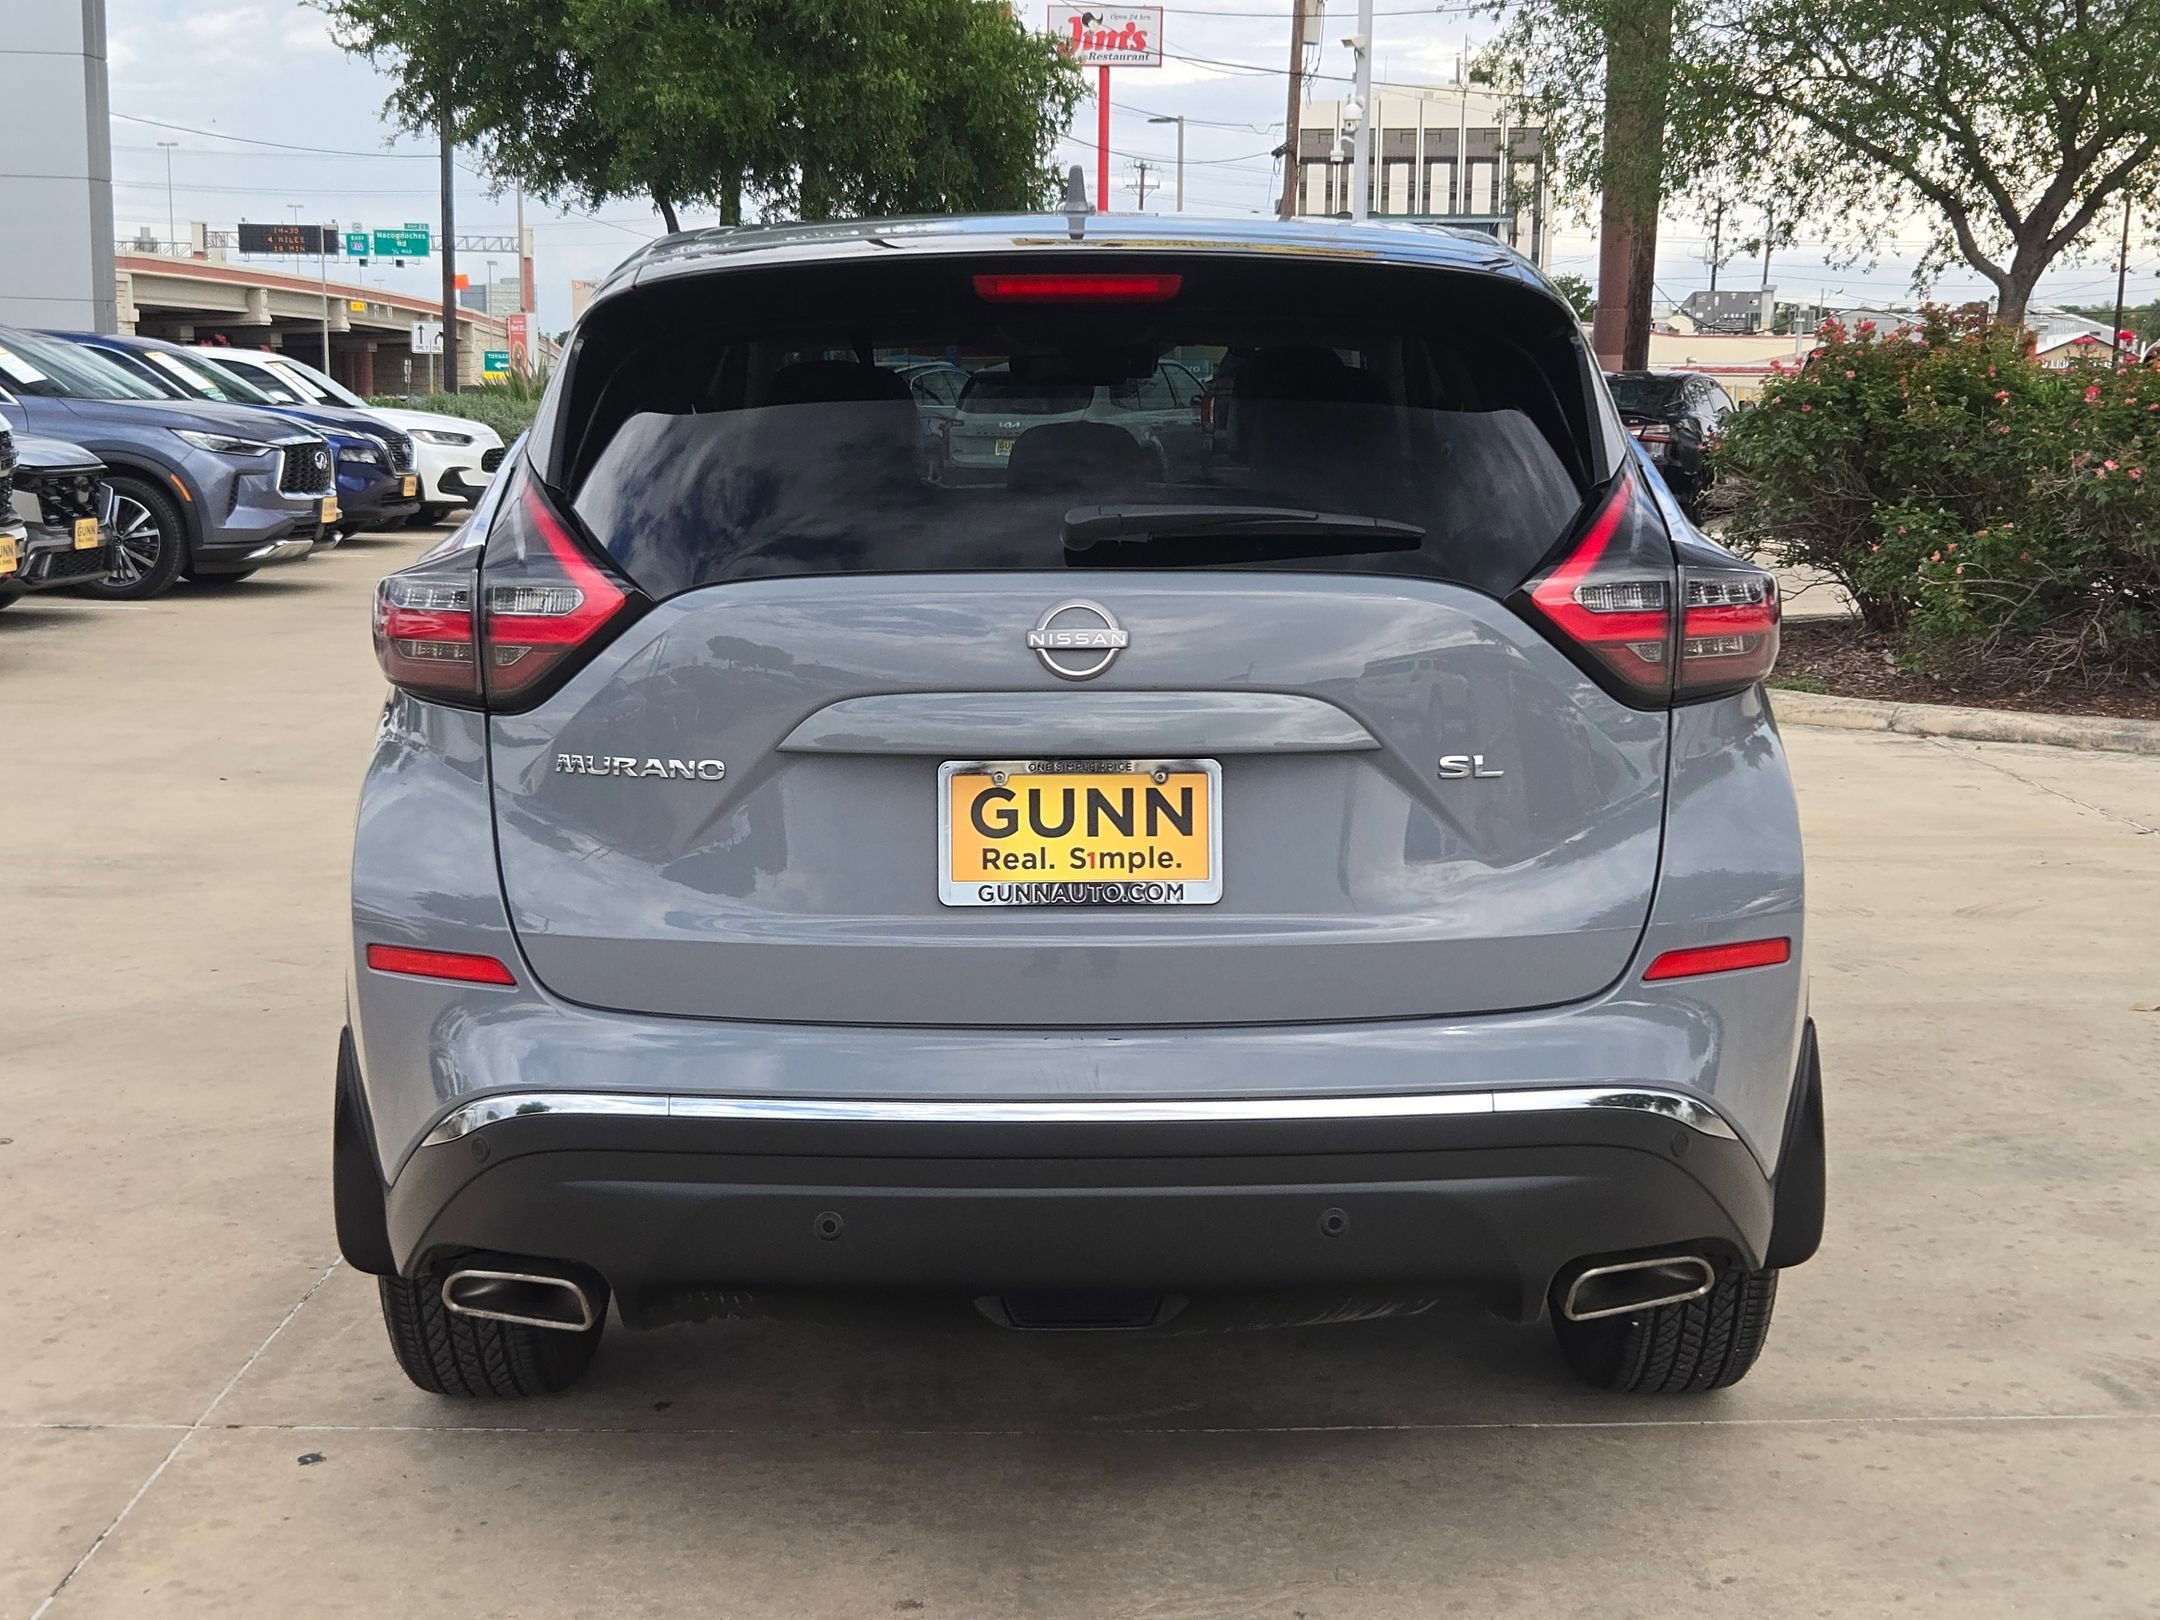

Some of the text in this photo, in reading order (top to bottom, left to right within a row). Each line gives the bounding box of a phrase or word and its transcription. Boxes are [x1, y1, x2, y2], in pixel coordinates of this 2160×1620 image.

[1110, 13, 1128, 21] Open
[1060, 16, 1148, 56] Jim's
[1088, 51, 1150, 61] Restaurant
[278, 236, 306, 244] MILES
[376, 231, 426, 240] Nacogdoches
[77, 525, 97, 537] GUNN
[0, 543, 14, 558] UNN
[1029, 633, 1126, 646] NISSAN
[555, 753, 726, 781] MURANO
[1028, 763, 1132, 772] ONE SIMPLE PRICE
[1439, 754, 1505, 779] SL
[970, 787, 1193, 839] GUNN
[982, 845, 1182, 873] Real. S1mple.
[977, 883, 1185, 903] GUNNAUTO.COM
